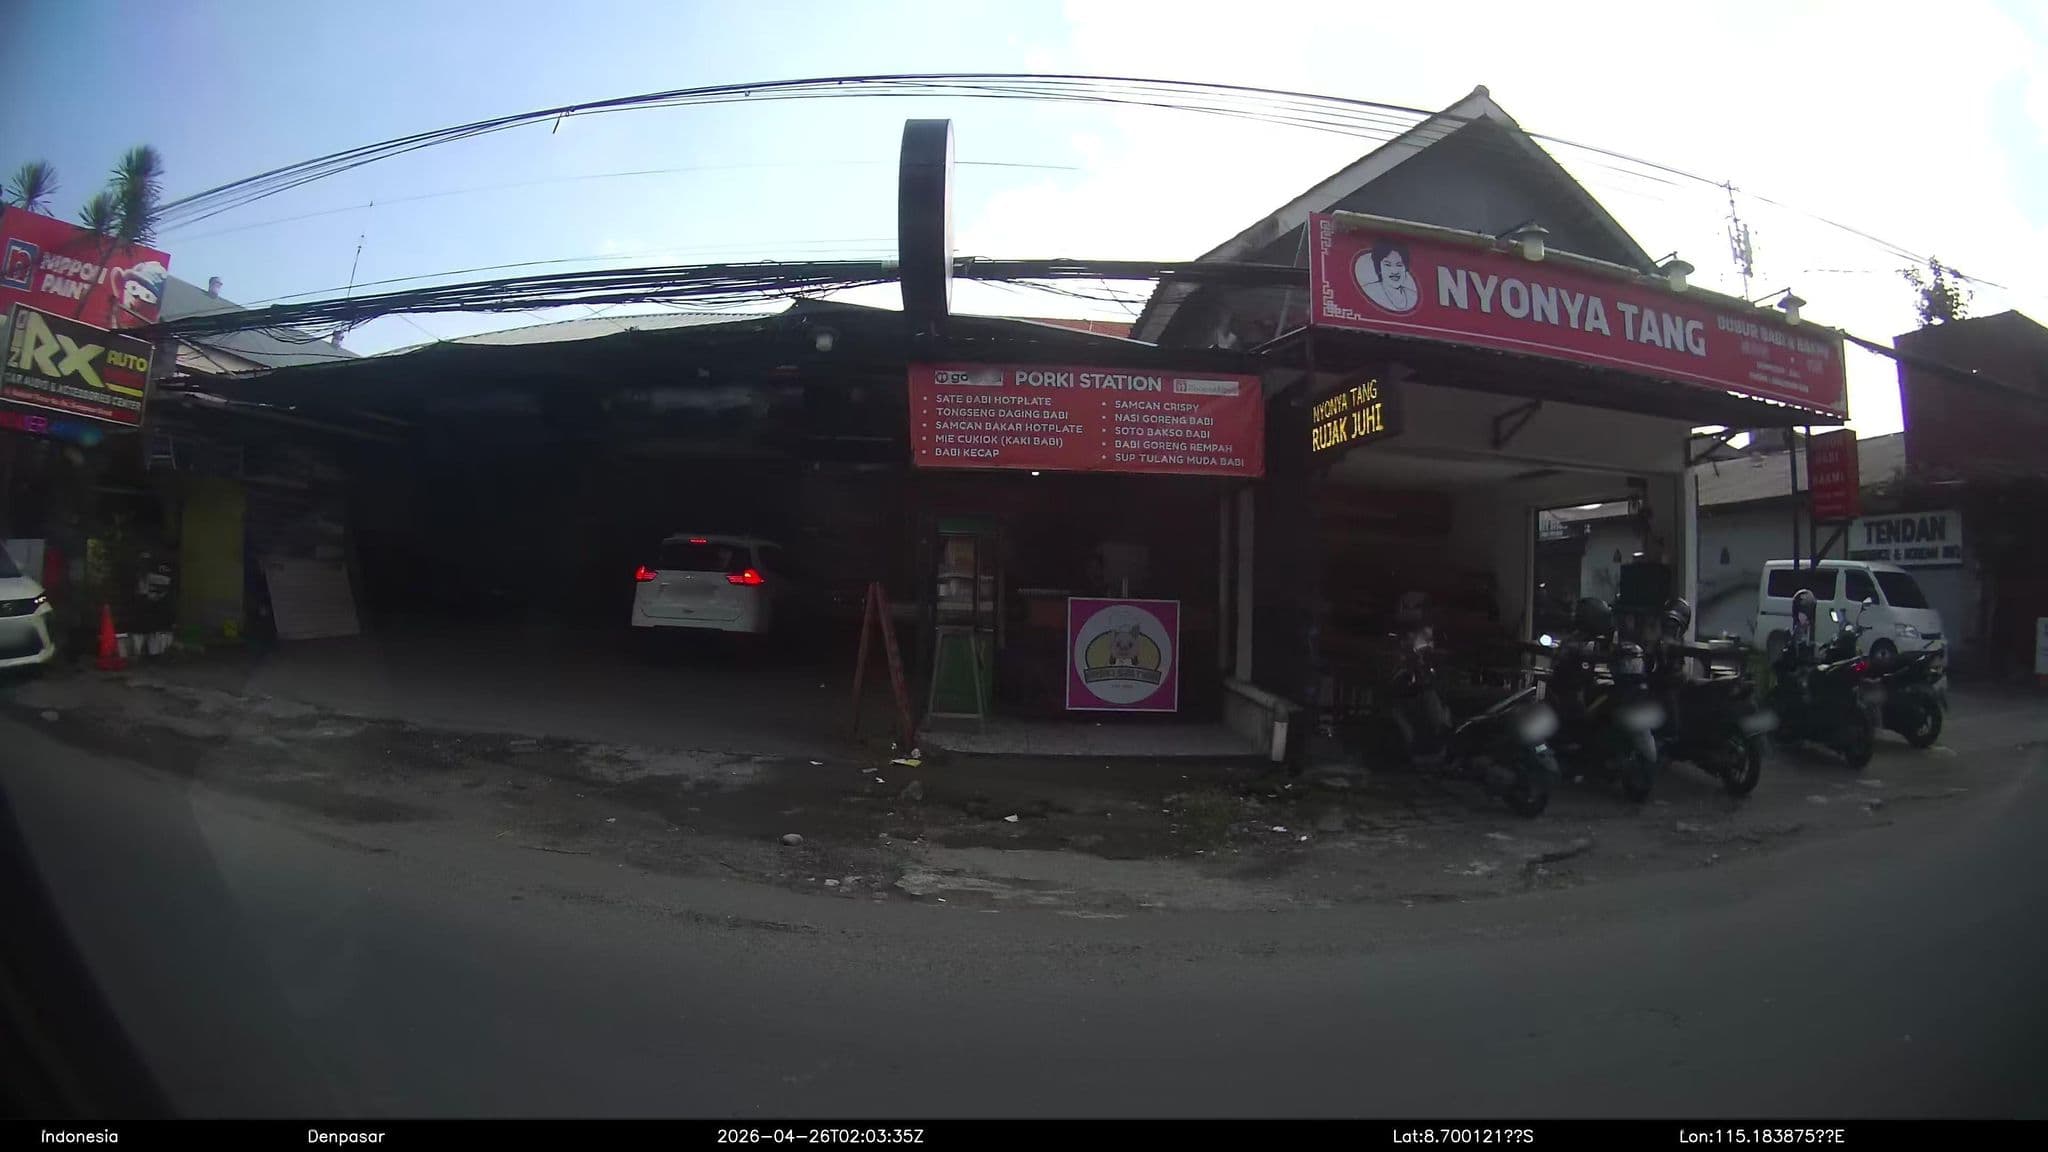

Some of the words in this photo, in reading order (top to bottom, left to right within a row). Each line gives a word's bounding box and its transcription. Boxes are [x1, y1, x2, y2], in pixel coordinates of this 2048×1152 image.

[1436, 266, 1611, 337] NYONYA
[1616, 302, 1707, 357] TANG
[107, 350, 147, 371] AUTO
[1015, 371, 1074, 387] PORKI
[1079, 373, 1162, 392] STATION
[936, 394, 963, 403] SATE
[966, 395, 991, 404] BABI
[994, 396, 1052, 406] HOTPLATE
[1313, 393, 1347, 423] NYONYA
[1350, 379, 1377, 407] TANG
[936, 407, 996, 417] TONGSENG
[998, 409, 1040, 419] DAGING
[1043, 410, 1068, 419] BABI
[1115, 401, 1161, 410] SAMCAN
[1163, 403, 1199, 413] CRISPY
[1115, 414, 1139, 422] NASI
[1142, 415, 1187, 425] GORENG
[1189, 417, 1213, 426] BABI
[935, 421, 982, 430] SAMCAN
[985, 422, 1022, 431] BAKAR
[1025, 424, 1083, 433] HOTPLATE
[1115, 427, 1144, 436] SOTO
[1147, 428, 1183, 438] BAKSO
[1186, 430, 1210, 439] BABI
[1312, 416, 1348, 452] RUJAK
[1351, 403, 1384, 439] JUHI
[935, 434, 955, 443] MIE
[1001, 437, 1031, 447] (KAKI
[1033, 437, 1063, 448] BABI)
[1115, 440, 1140, 449] BABI
[1143, 441, 1187, 451] GORENG
[1190, 443, 1232, 453] REMPAH
[935, 447, 960, 456] BABI
[963, 448, 1000, 457] KECAP
[1115, 453, 1136, 462] SUP
[1139, 454, 1184, 464] TULANG
[1187, 456, 1217, 465] MUDA
[1220, 458, 1244, 467] BABI
[1864, 516, 1946, 544] TENDAN
